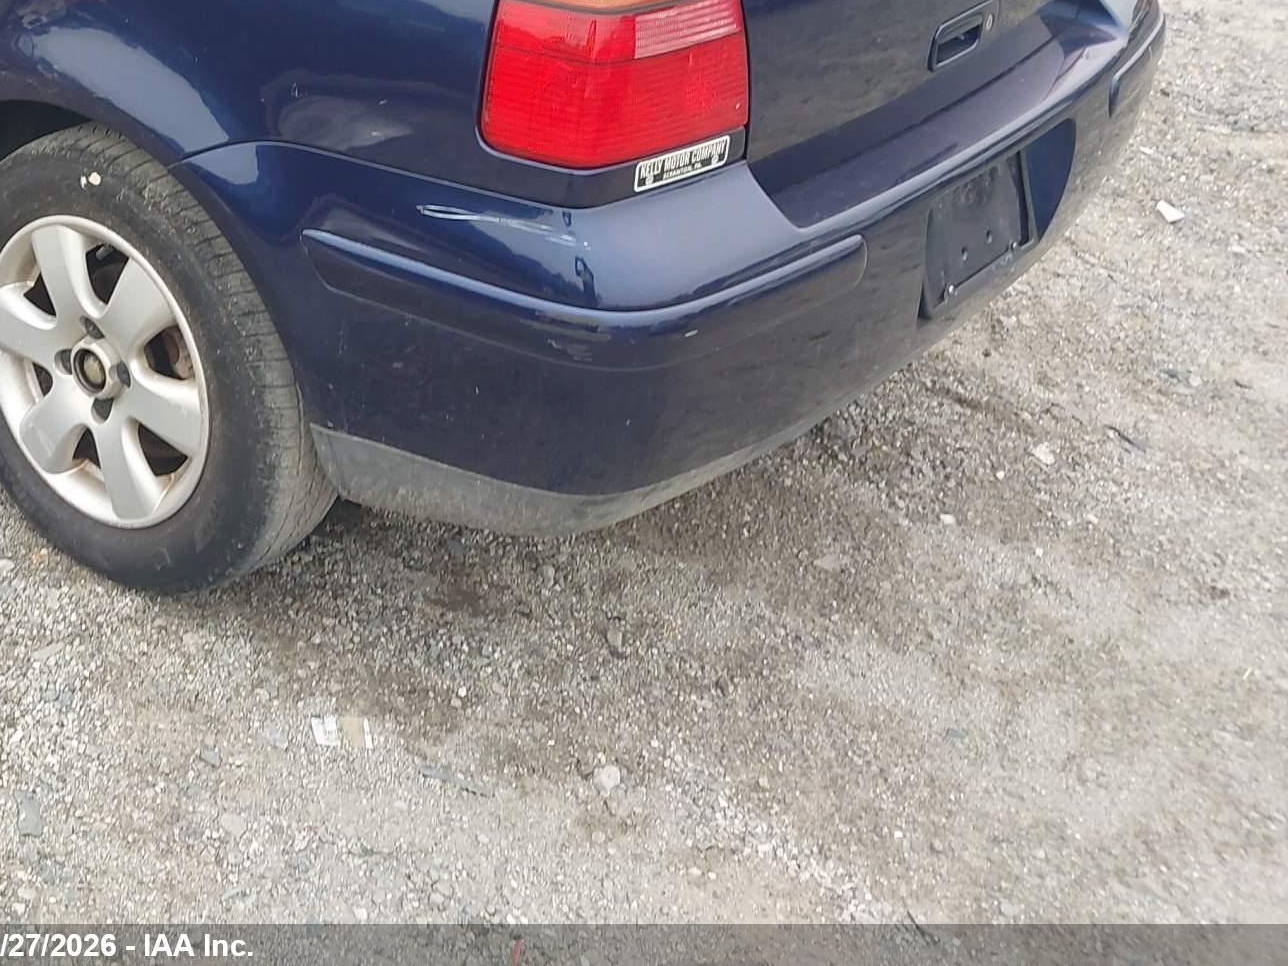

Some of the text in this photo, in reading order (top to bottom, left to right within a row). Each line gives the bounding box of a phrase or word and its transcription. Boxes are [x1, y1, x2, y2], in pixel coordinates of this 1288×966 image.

[640, 139, 726, 179] KELLY MOTOR COMPANY
